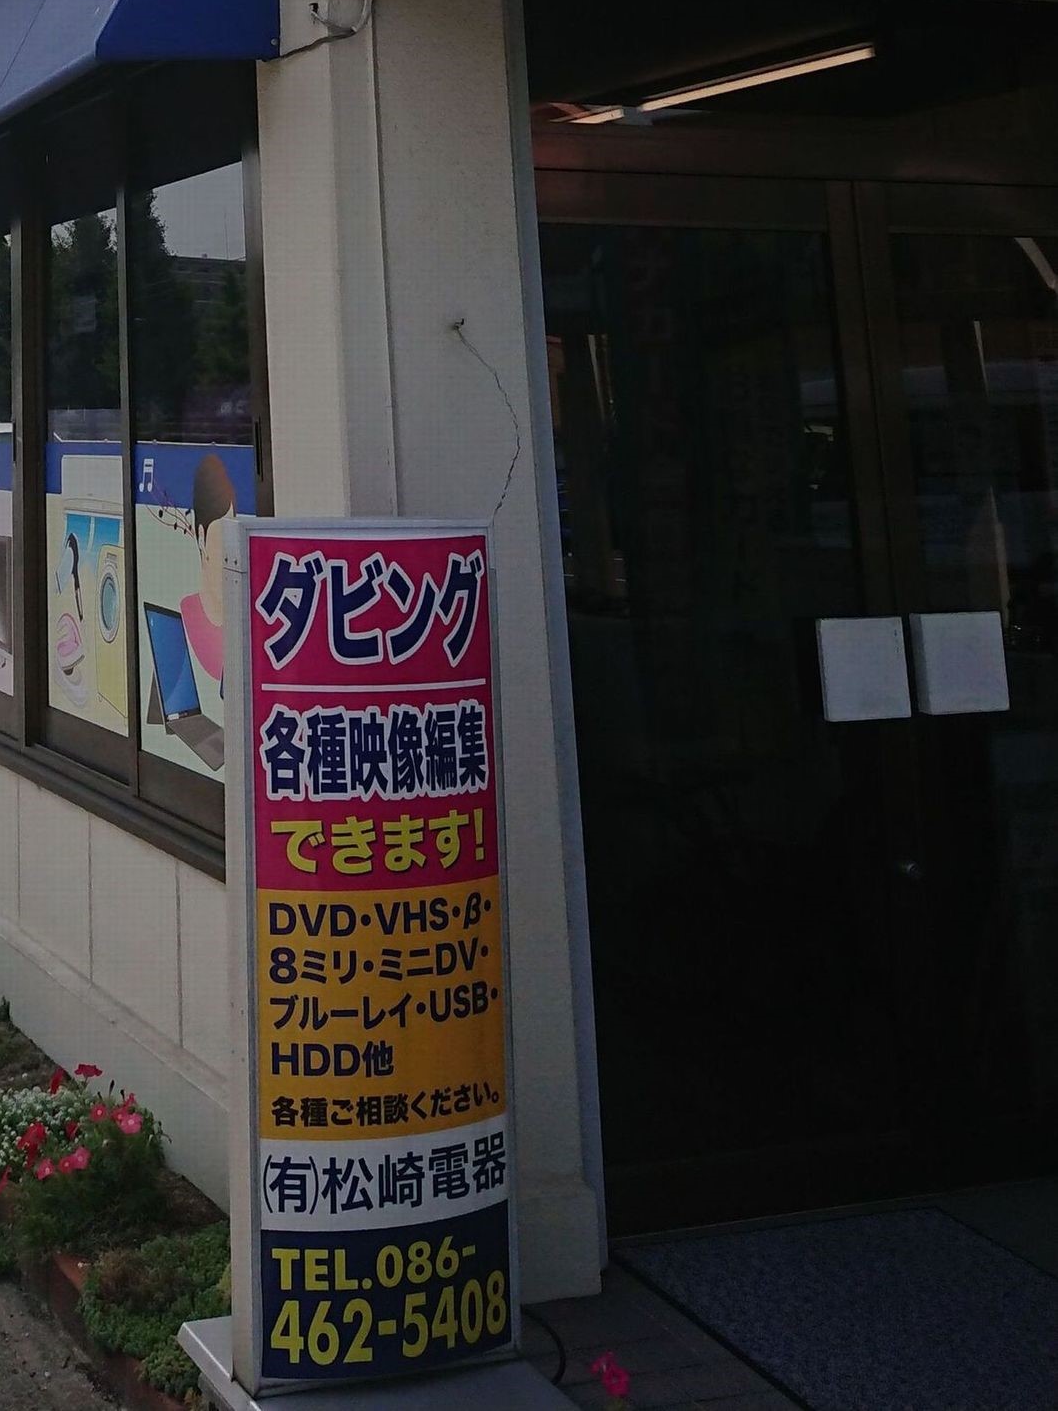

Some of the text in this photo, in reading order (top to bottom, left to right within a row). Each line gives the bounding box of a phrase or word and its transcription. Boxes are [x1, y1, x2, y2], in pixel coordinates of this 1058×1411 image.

[256, 549, 485, 670] ダビング
[262, 699, 489, 802] 各種映像編集
[271, 808, 485, 876] できます!
[271, 1041, 394, 1079] HDD他
[271, 1090, 500, 1128] 各種ご相談ください。
[263, 1131, 507, 1216] (有)松崎電器
[271, 1236, 476, 1292] TEL.086-
[271, 1269, 508, 1367] 462-5408
